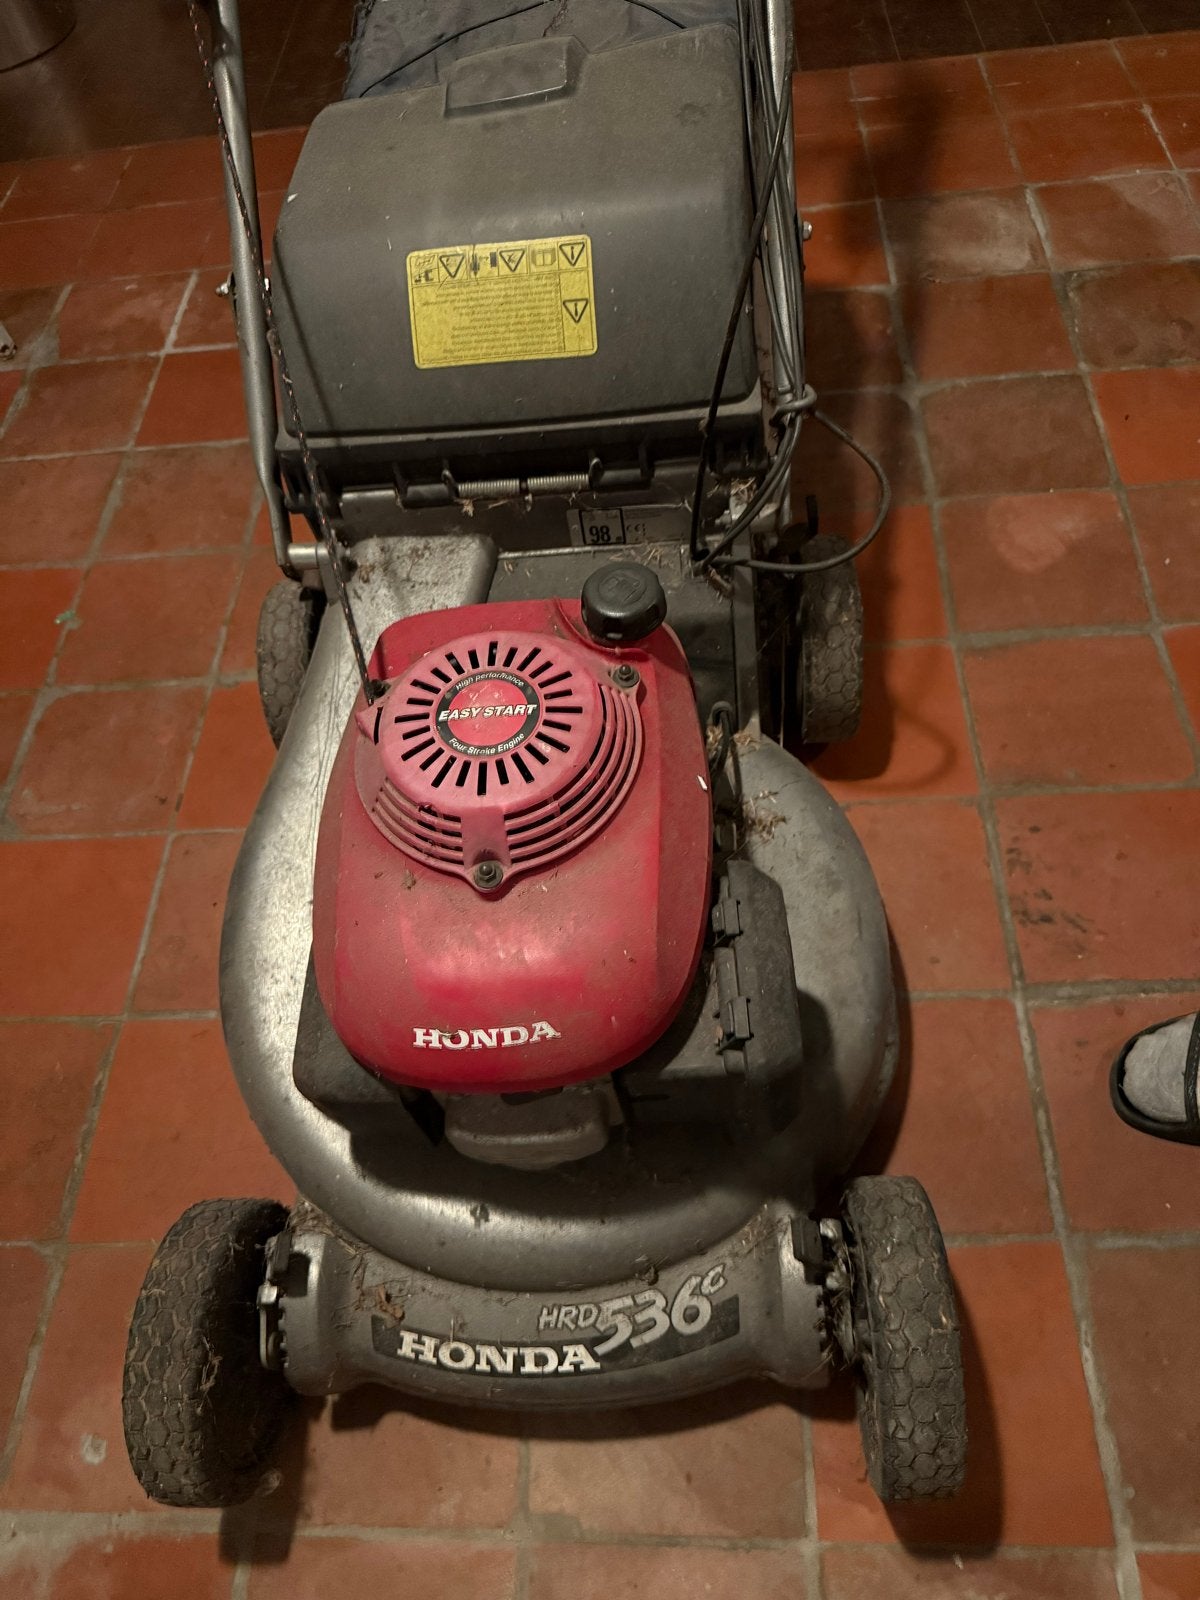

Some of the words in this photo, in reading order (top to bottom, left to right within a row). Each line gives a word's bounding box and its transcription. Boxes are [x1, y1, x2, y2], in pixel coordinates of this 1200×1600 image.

[588, 525, 612, 544] 98
[455, 677, 474, 691] High
[475, 672, 525, 687] performance
[438, 707, 481, 721] EASY
[483, 704, 537, 717] START
[448, 737, 469, 752] Four
[497, 733, 525, 753] Engine
[412, 1020, 562, 1050] HONDA
[396, 1330, 601, 1375] HONDA
